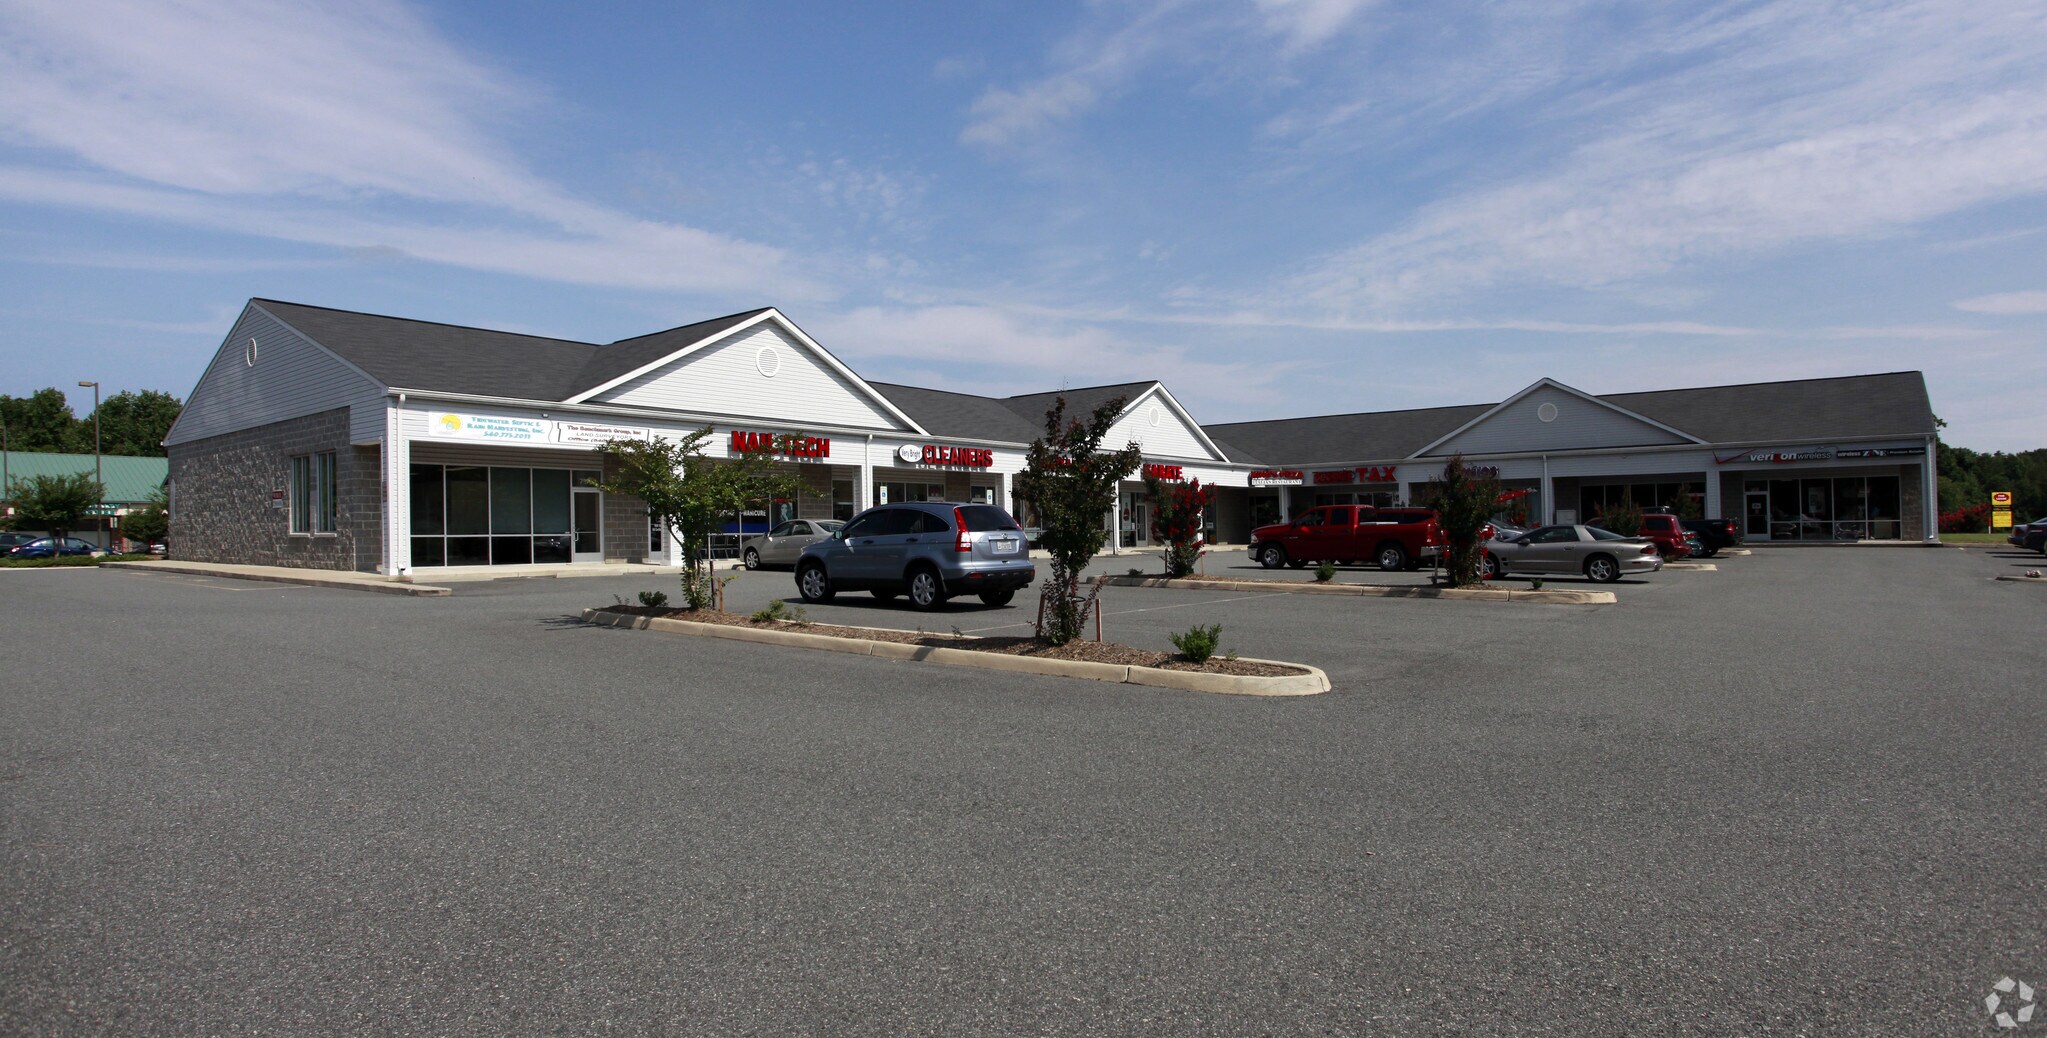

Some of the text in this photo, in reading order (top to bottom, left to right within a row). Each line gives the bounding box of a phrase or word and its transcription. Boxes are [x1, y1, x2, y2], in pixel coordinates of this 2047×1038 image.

[784, 435, 830, 457] TECH
[901, 448, 921, 459] Very Bright
[922, 444, 993, 467] CLEANERS
[1355, 465, 1397, 483] TAX
